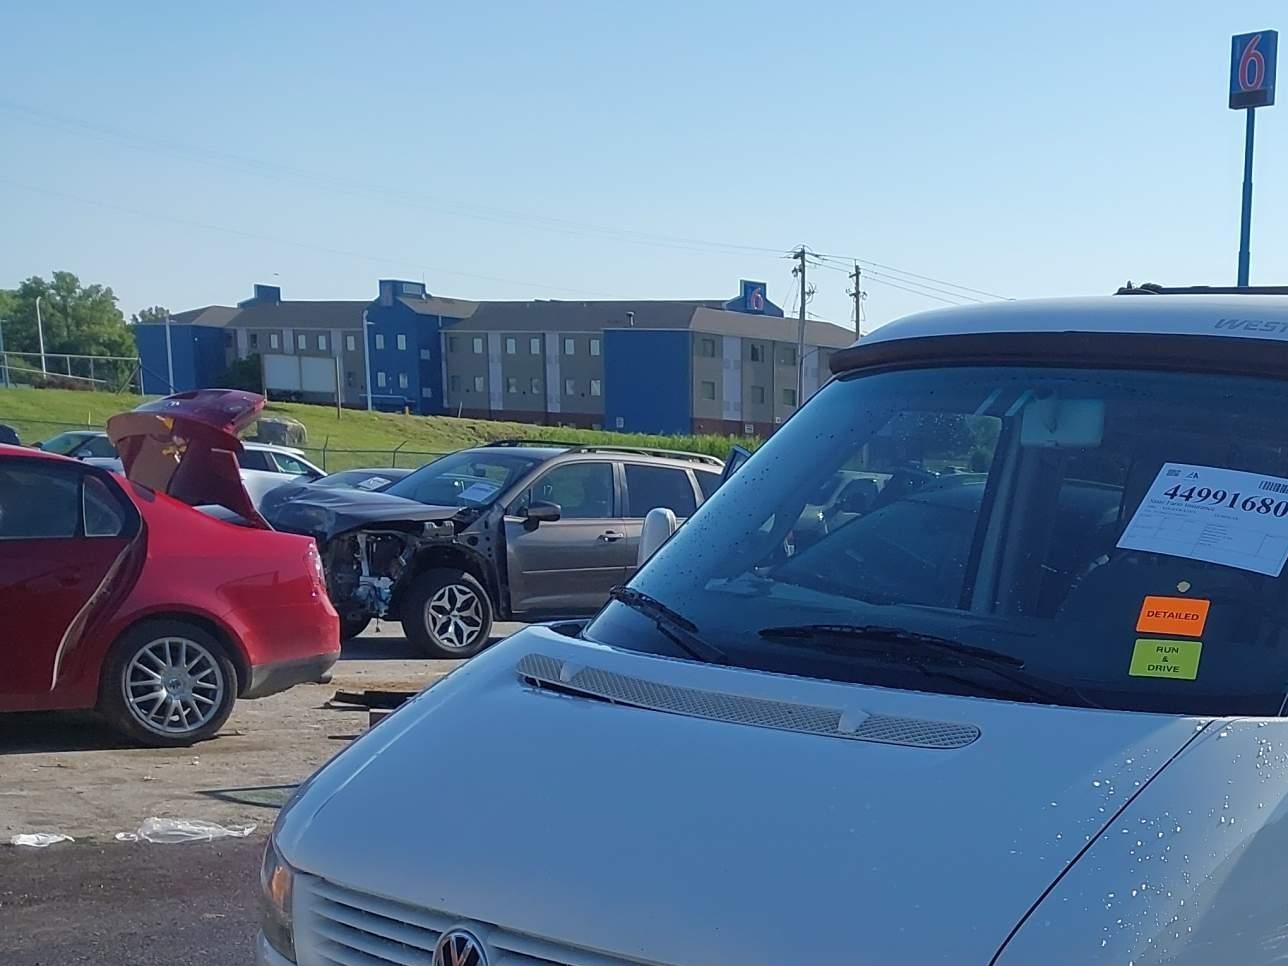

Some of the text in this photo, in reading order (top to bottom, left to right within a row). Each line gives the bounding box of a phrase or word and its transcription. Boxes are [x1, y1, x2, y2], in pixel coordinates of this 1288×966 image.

[1238, 33, 1265, 92] 6
[1146, 610, 1199, 621] DETAILED
[1156, 646, 1179, 654] RUN
[1147, 664, 1180, 673] DRIVE
